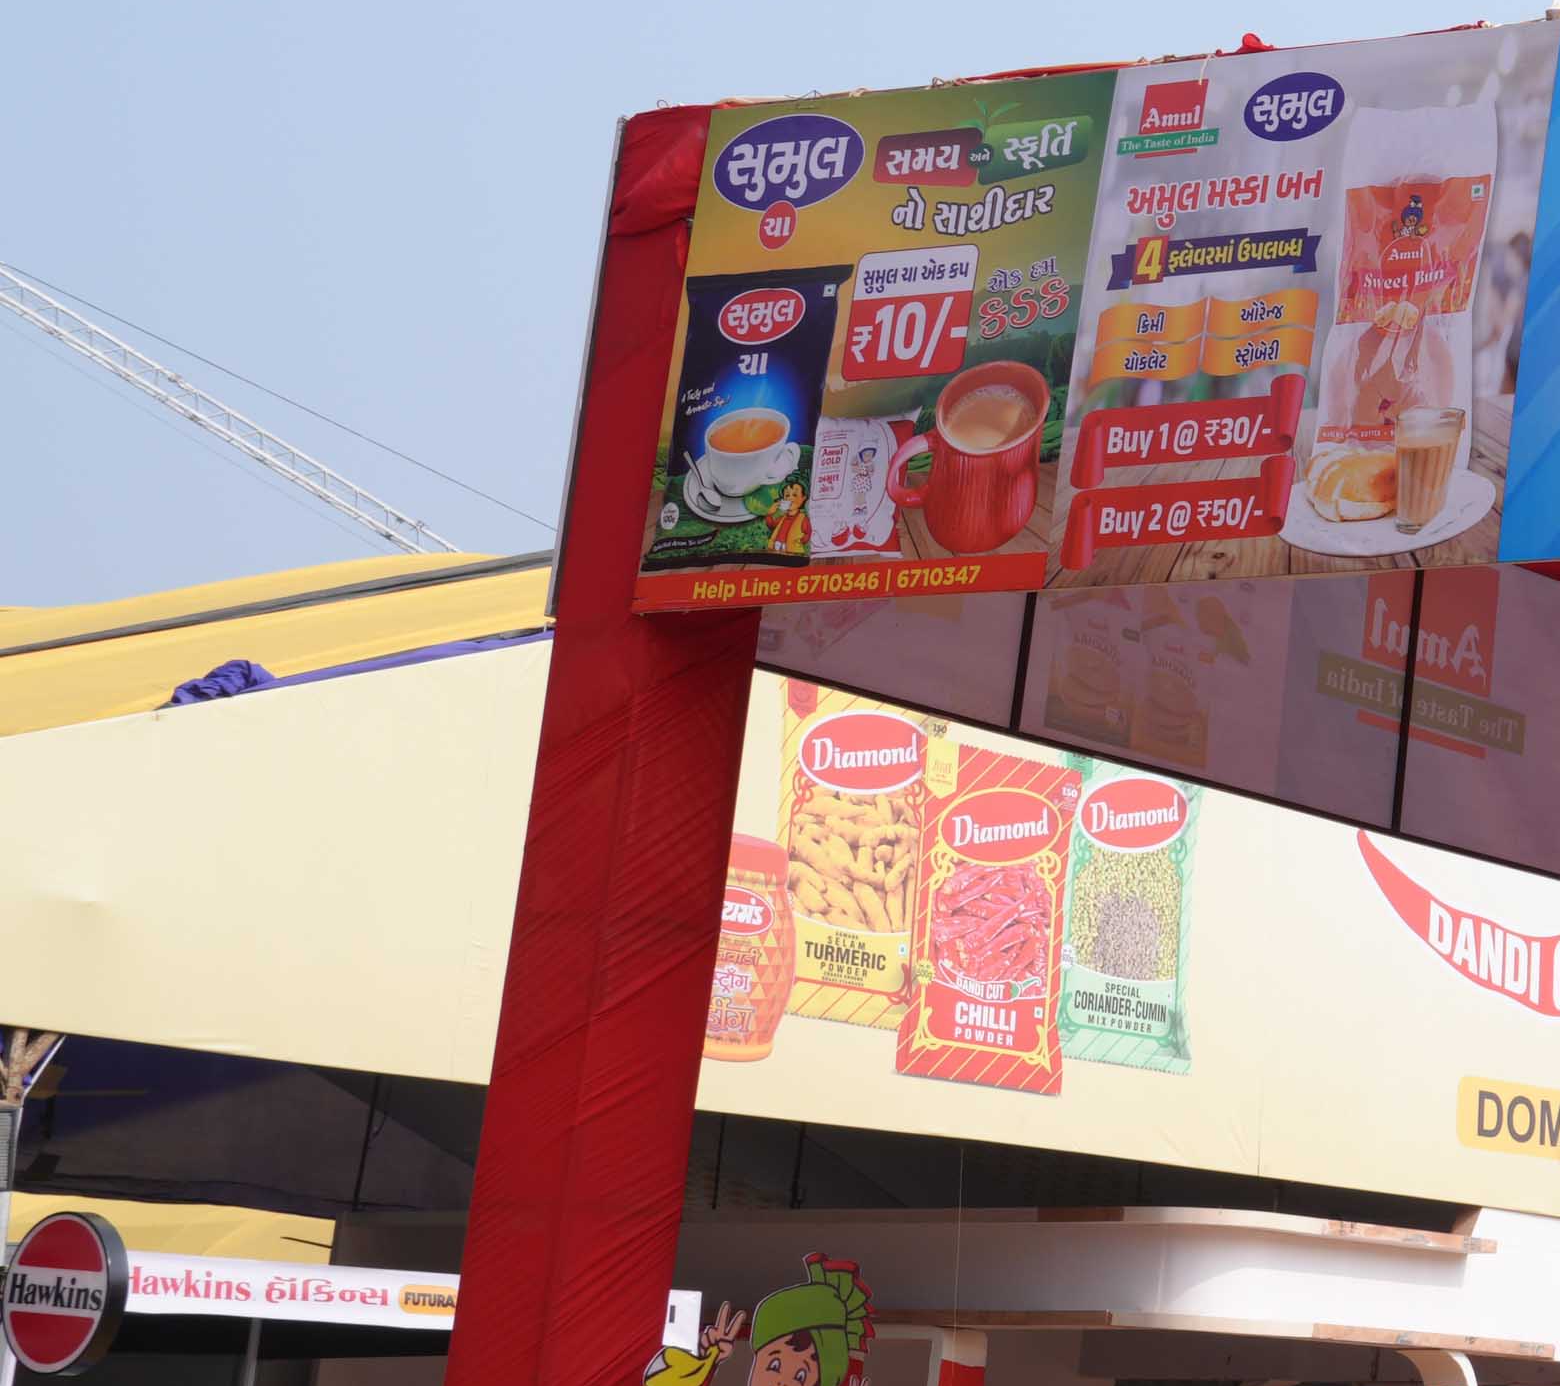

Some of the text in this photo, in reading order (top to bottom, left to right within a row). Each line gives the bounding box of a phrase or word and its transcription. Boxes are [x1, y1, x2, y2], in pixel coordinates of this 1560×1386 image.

[1141, 105, 1201, 131] Amul
[1252, 87, 1334, 134] સુમુલ
[727, 135, 849, 202] સુમુલ
[884, 143, 961, 176] સમય
[893, 185, 1055, 236] નો સાથીદાર
[1127, 168, 1324, 228] અમુલ મસ્કા બન
[763, 215, 791, 238] ચા
[1388, 248, 1424, 262] Amul
[1364, 268, 1445, 290] Sweet Bun
[726, 297, 795, 333] સુમુલ
[978, 277, 1070, 340] કડક
[851, 296, 968, 369] ₹10/-
[738, 352, 768, 377] ચા
[1124, 353, 1168, 374] ચોકલેટ
[1107, 414, 1272, 458] Buy 1 @ ₹30/-
[1099, 496, 1263, 539] Buy 2 @ ₹50/-
[693, 579, 736, 601] Help
[740, 577, 781, 596] Line
[797, 573, 879, 595] 6710346
[897, 565, 981, 589] 6710347
[811, 734, 918, 772] Diamond
[952, 807, 1049, 847] Diamond
[1089, 794, 1180, 834] Diamond
[805, 940, 886, 971] TURMERIC
[827, 936, 867, 950] SELAM
[1427, 898, 1543, 1009] DANDI
[820, 961, 868, 978] POWDER
[986, 982, 1005, 1000] CUT
[1074, 990, 1167, 1023] CORIANDER-CUMIN
[1104, 982, 1141, 999] SPECIAL
[954, 1001, 1017, 1031] CHILLI
[1087, 1013, 1153, 1034] MIX POWDER
[955, 1027, 1015, 1046] POWDER
[9, 1271, 102, 1313] Hawkins
[128, 1266, 252, 1302] Hawkins
[403, 1290, 455, 1309] FUTURA
